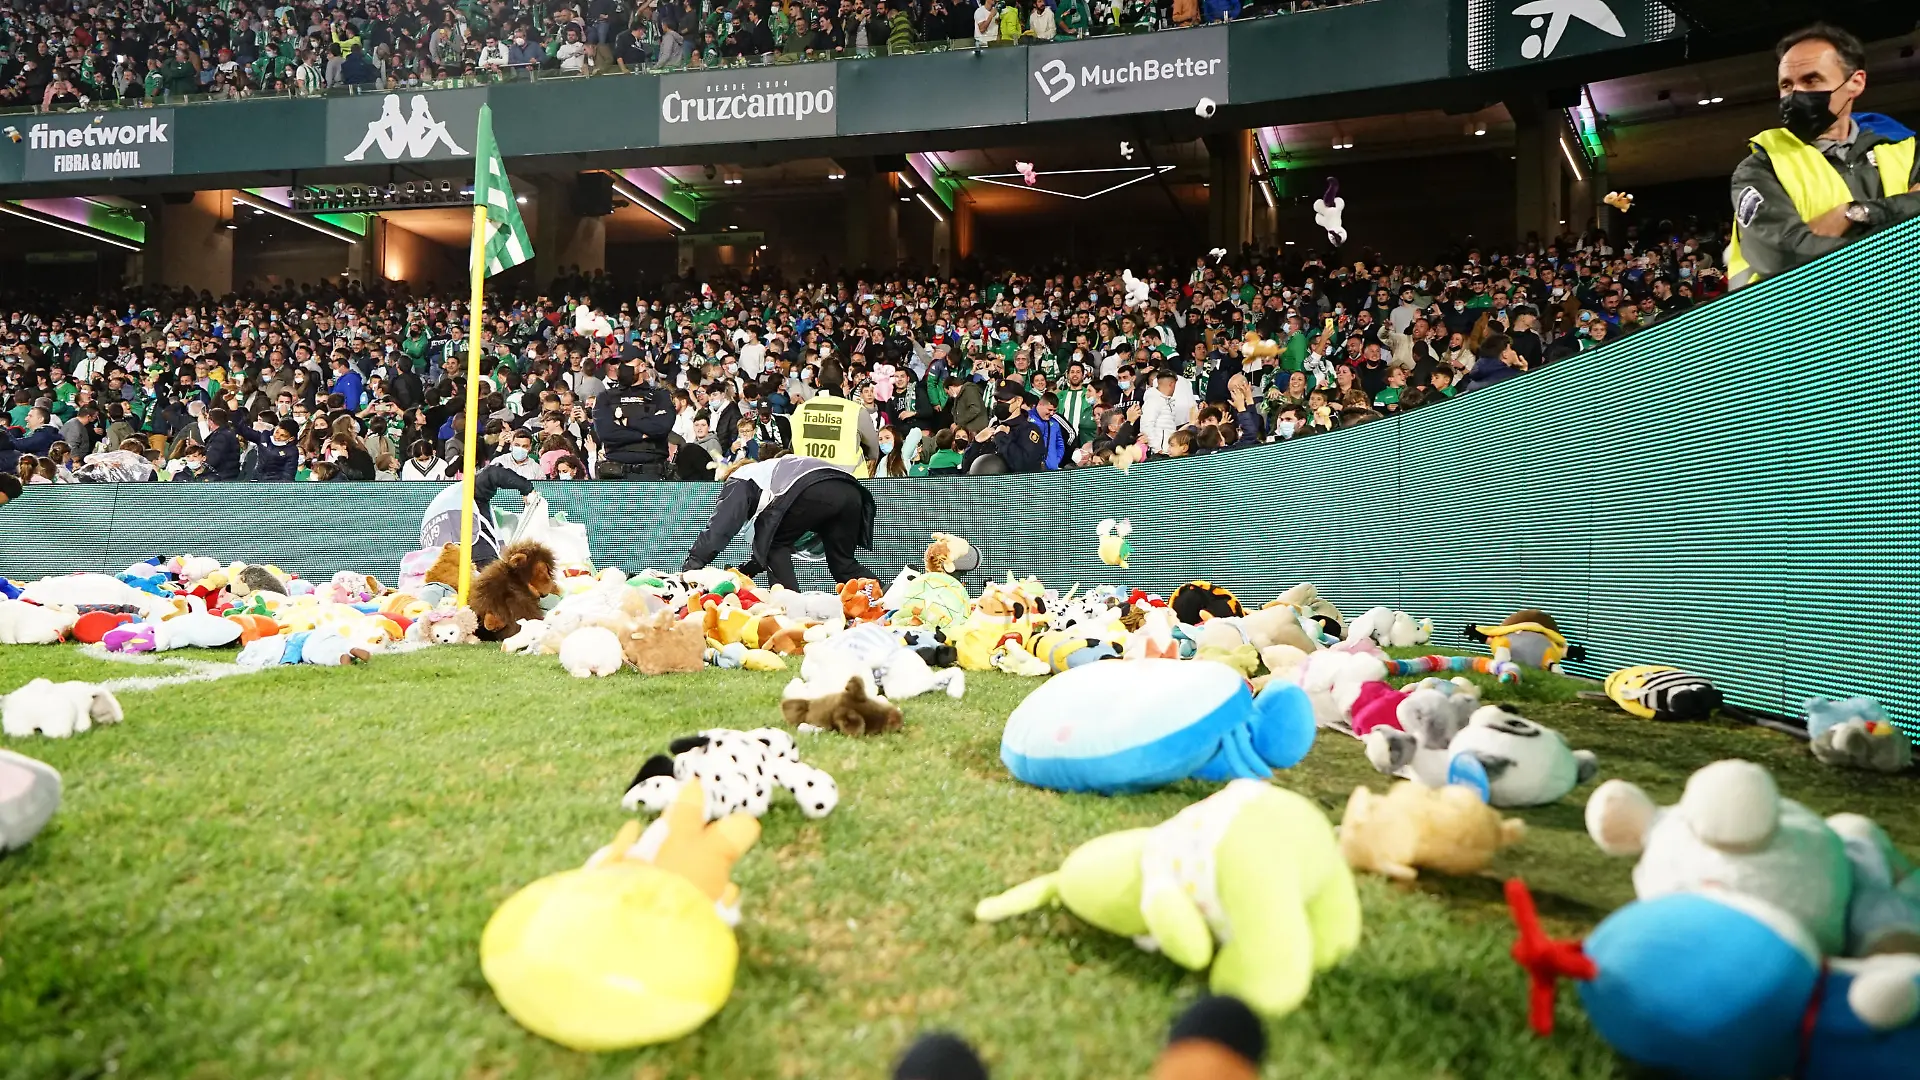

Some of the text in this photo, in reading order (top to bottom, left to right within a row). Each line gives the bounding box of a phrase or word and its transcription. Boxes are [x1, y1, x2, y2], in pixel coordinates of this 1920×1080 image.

[1081, 57, 1221, 87] MuchBetter
[706, 83, 745, 92] DESDE
[662, 89, 834, 123] Cruzcampo
[29, 117, 168, 149] finetwork
[54, 149, 141, 172] FIBRA & MÓVIL
[803, 412, 842, 425] Trablisa
[805, 443, 836, 458] 1020
